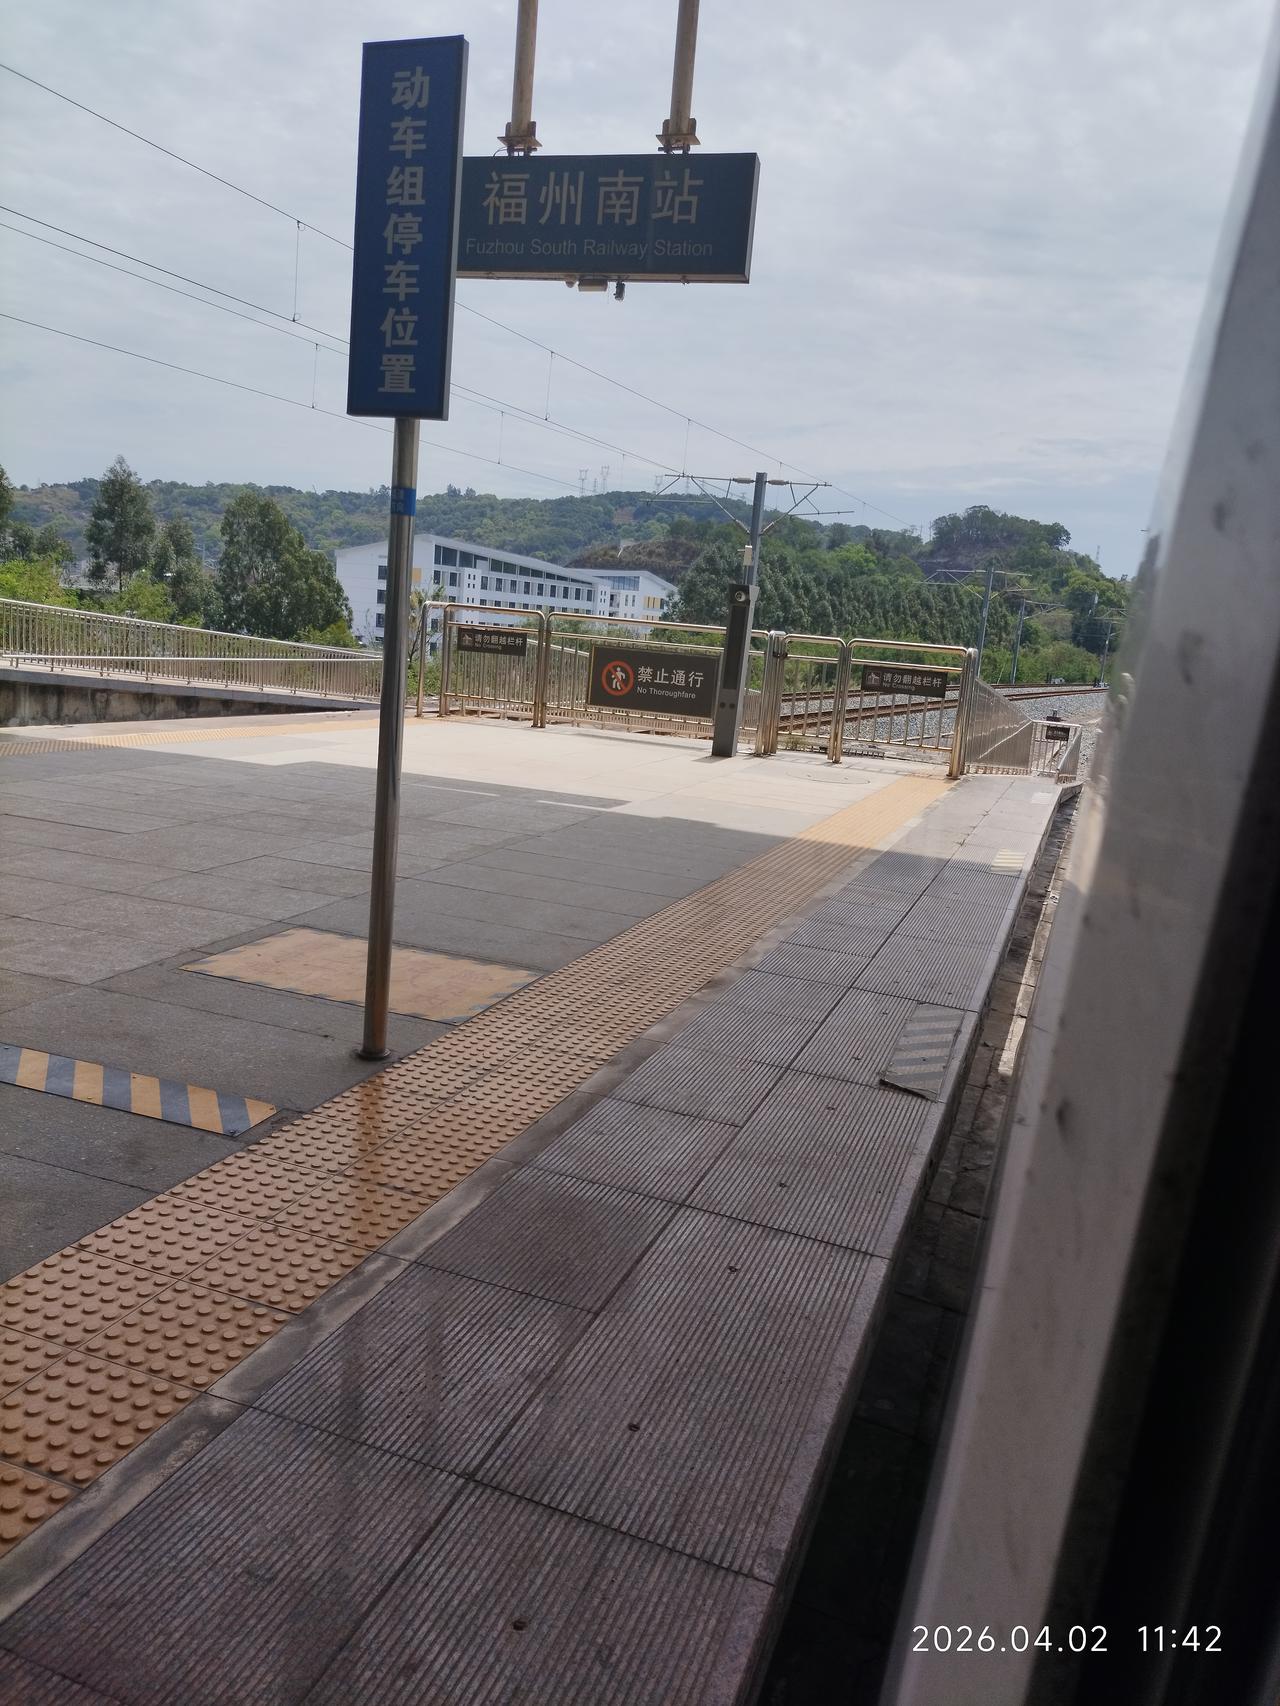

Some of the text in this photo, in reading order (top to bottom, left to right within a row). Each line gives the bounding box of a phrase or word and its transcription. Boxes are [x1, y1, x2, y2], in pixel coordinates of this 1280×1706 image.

[483, 168, 704, 225] 福州南站
[378, 65, 430, 394] 动车组停车位置
[465, 238, 713, 260] Fuzhou South Railway Station
[637, 665, 704, 688] 禁止通行
[883, 672, 942, 688] 请勿翻越栏杆
[636, 686, 696, 699] No Thoroughfare
